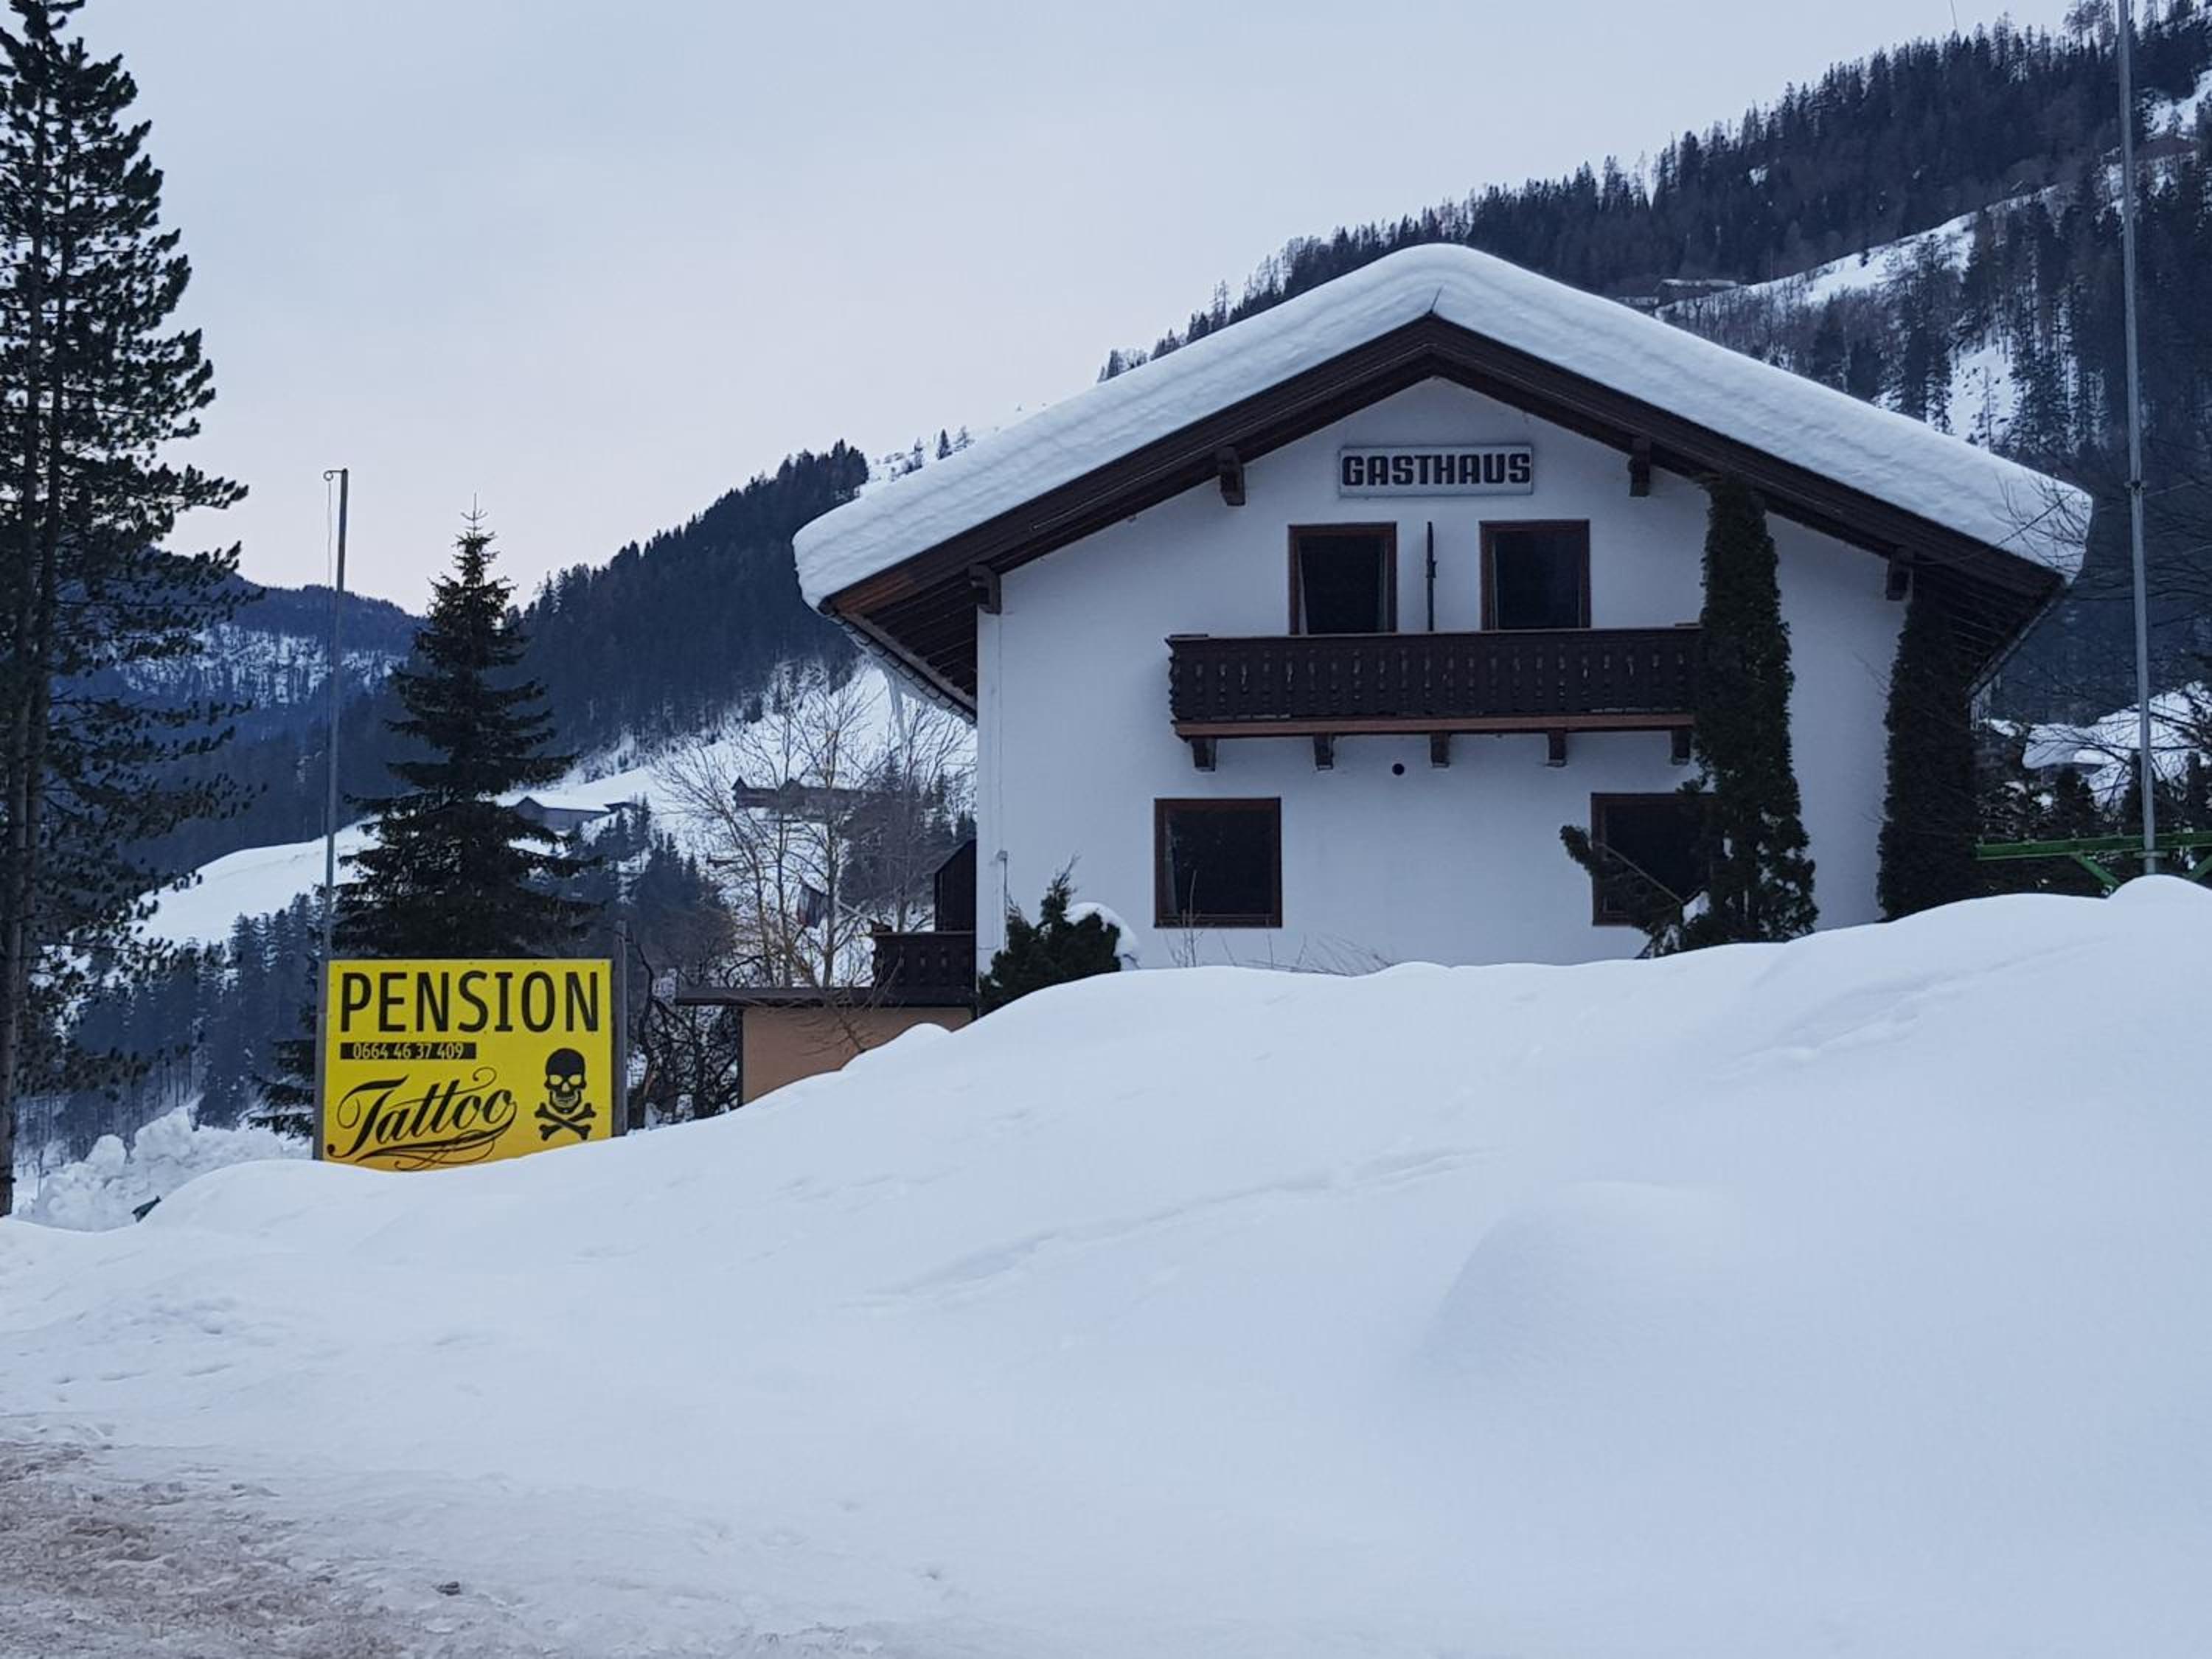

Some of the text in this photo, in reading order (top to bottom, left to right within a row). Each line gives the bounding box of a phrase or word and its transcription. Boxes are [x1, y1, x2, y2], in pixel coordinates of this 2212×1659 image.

[1341, 453, 1531, 487] GASTHAUS
[340, 970, 599, 1033] PENSION
[352, 1043, 465, 1060] 0664 46 37 409
[326, 1066, 518, 1161] Tattoo
